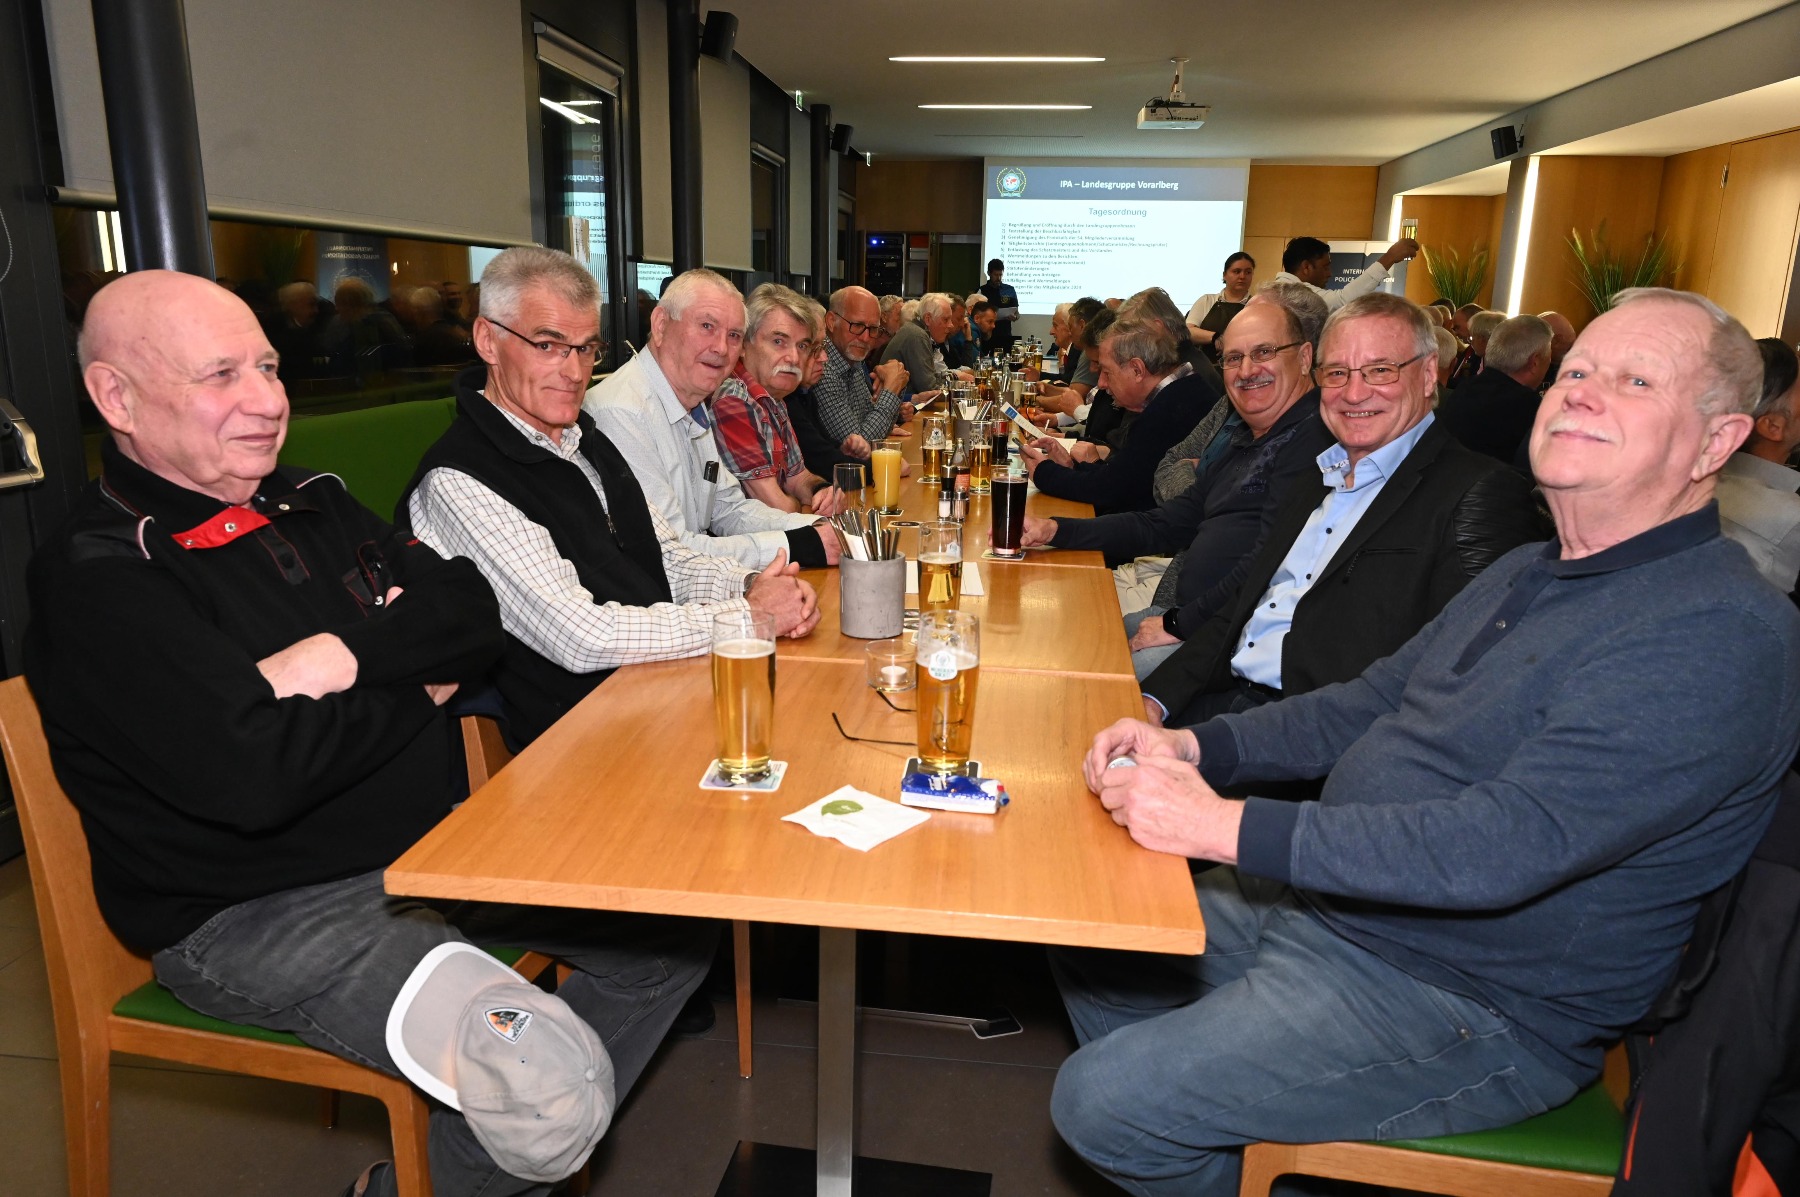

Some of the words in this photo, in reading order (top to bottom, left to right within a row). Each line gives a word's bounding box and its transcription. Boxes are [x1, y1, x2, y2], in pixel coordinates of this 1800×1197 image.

[1060, 180, 1073, 188] IPA
[1081, 180, 1136, 190] Landesgruppe
[1137, 180, 1179, 191] Vorarlberg
[1089, 207, 1147, 217] Tagesordnung
